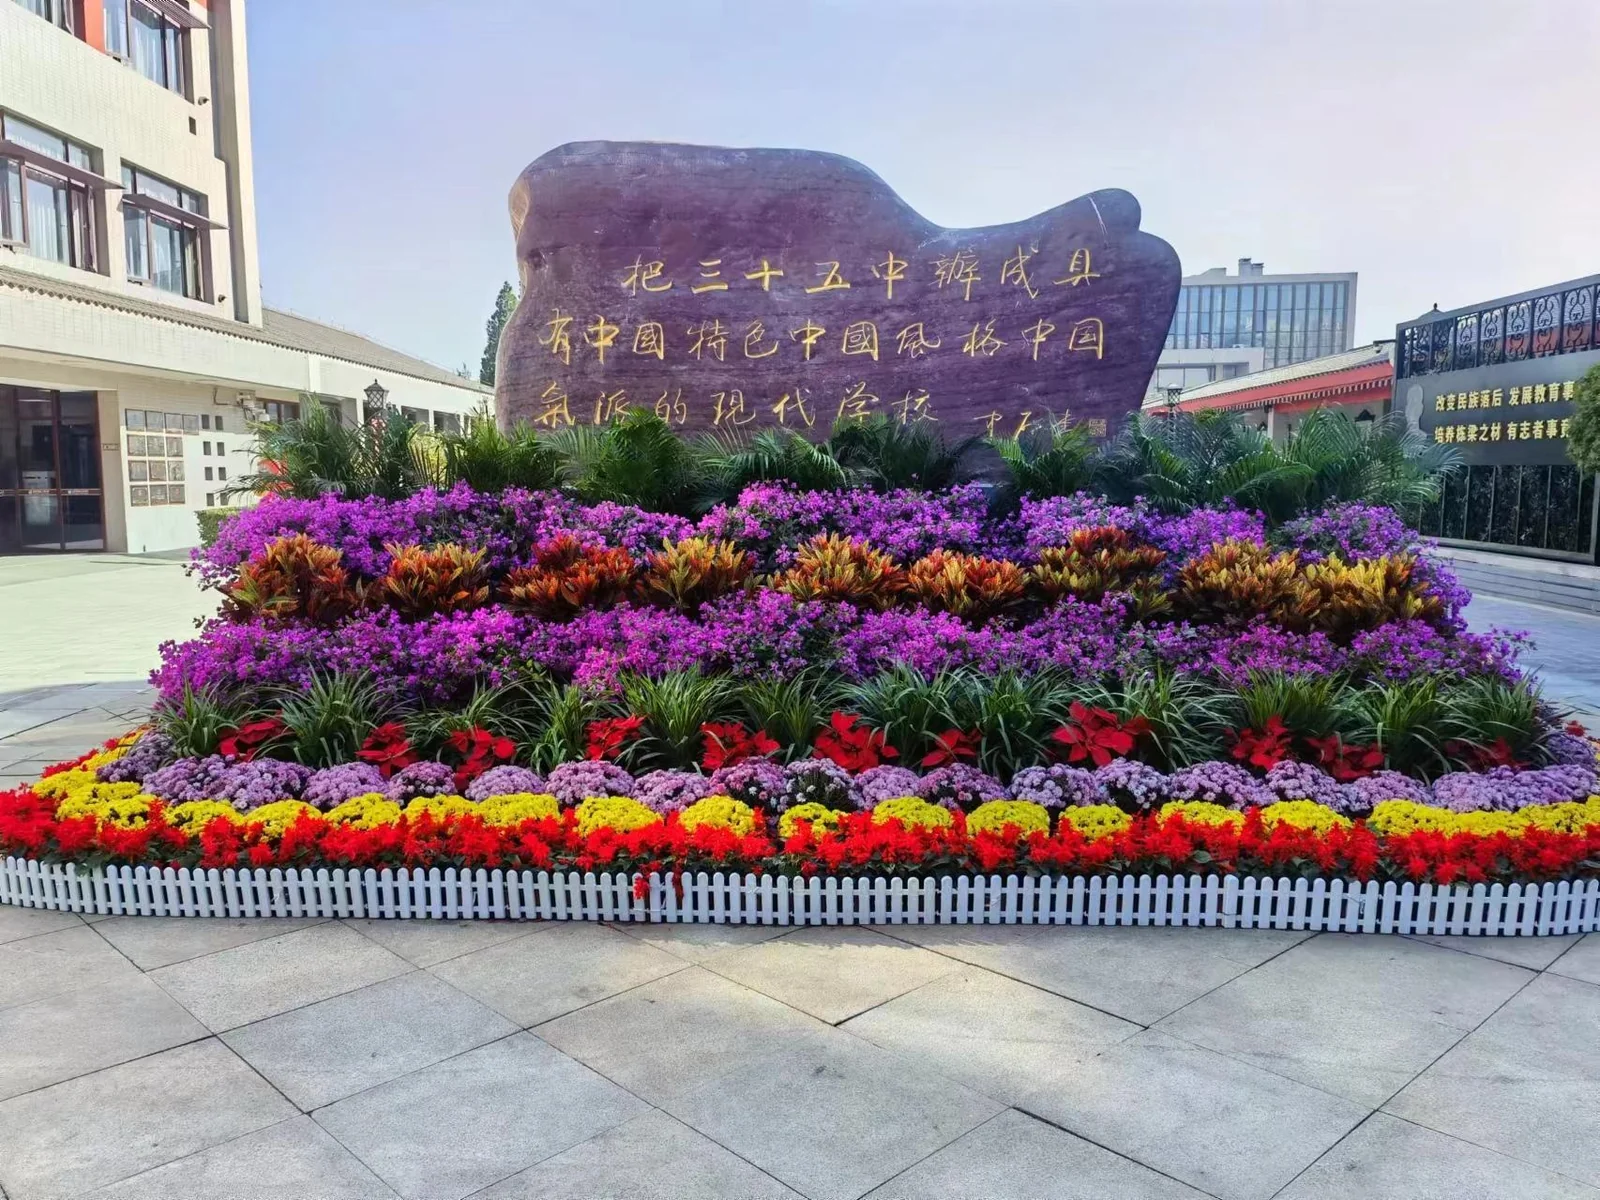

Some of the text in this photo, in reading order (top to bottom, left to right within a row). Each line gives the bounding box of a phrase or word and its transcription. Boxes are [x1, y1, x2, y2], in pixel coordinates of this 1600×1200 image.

[1436, 388, 1503, 412] 改变民族落后
[1435, 421, 1502, 444] 培养栋梁之材
